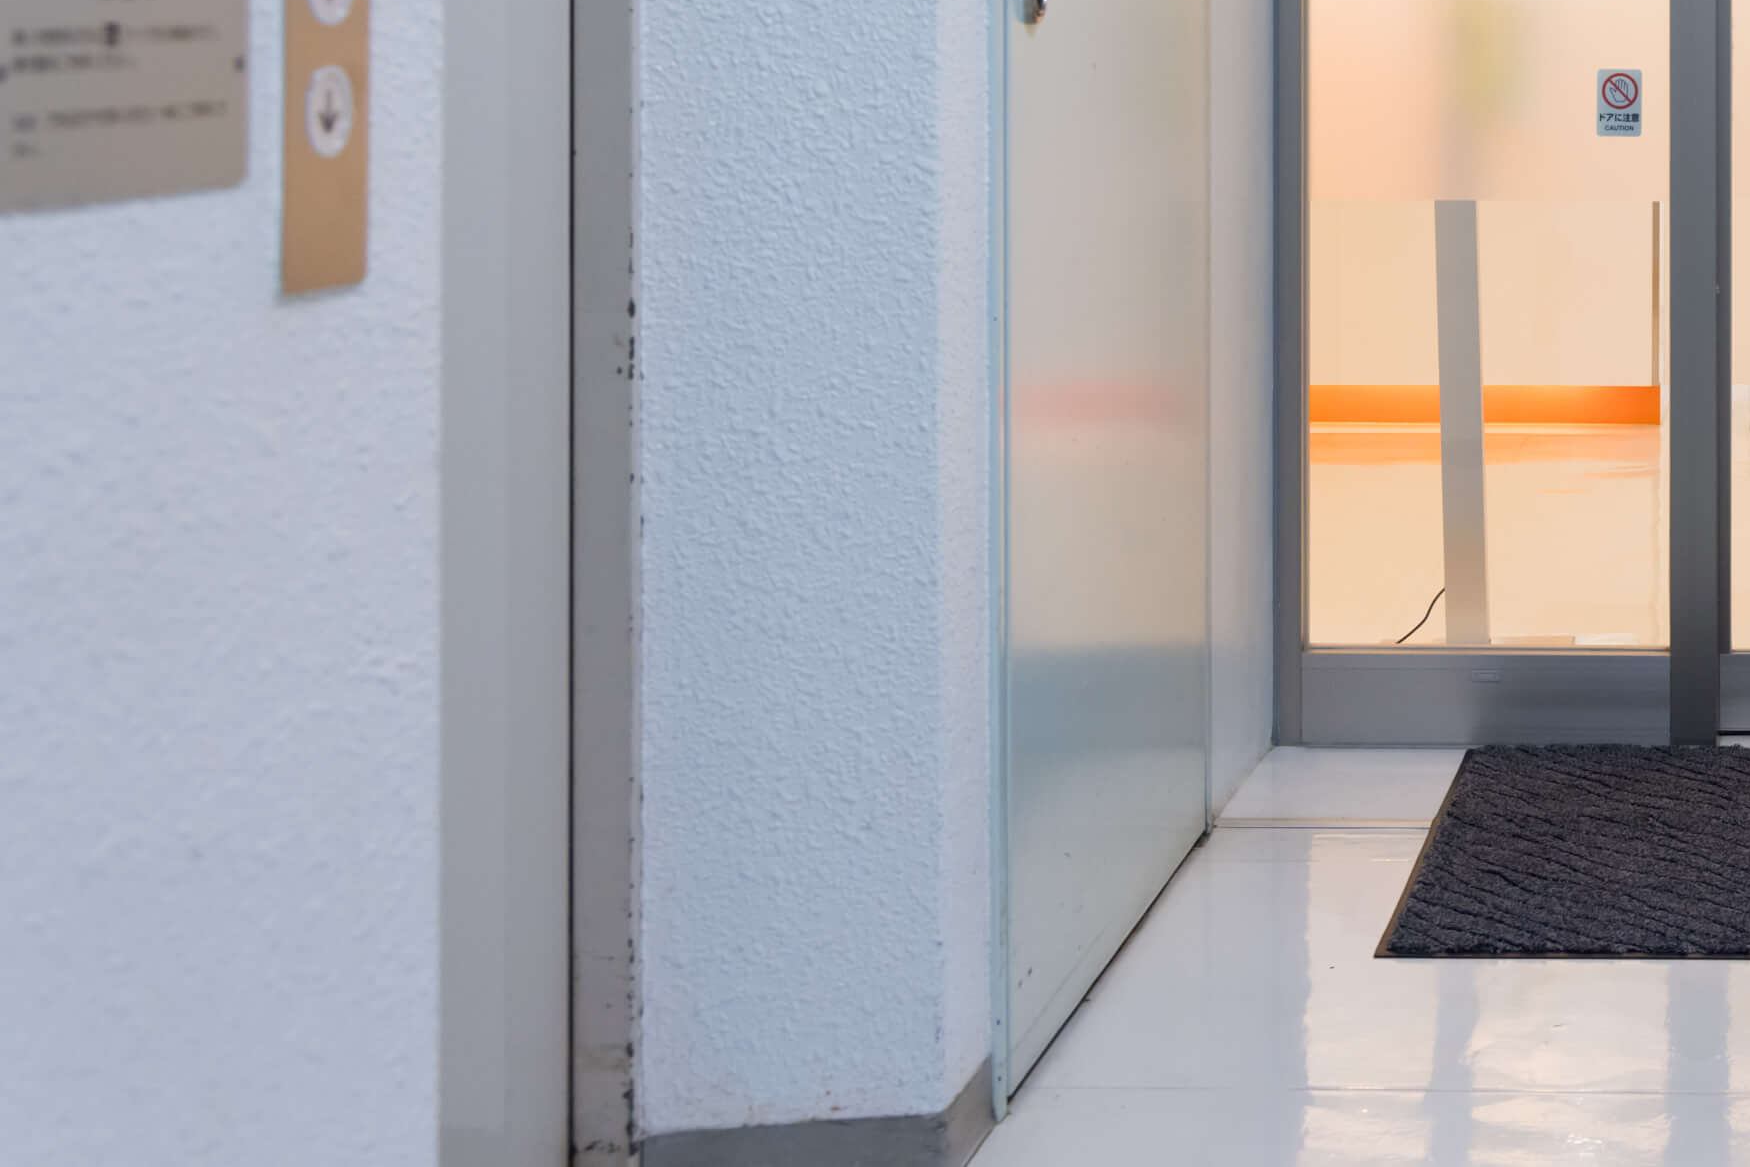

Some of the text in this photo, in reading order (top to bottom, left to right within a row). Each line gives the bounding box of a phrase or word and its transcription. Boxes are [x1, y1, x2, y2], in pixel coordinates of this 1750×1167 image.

[1599, 113, 1639, 122] ドアに注意
